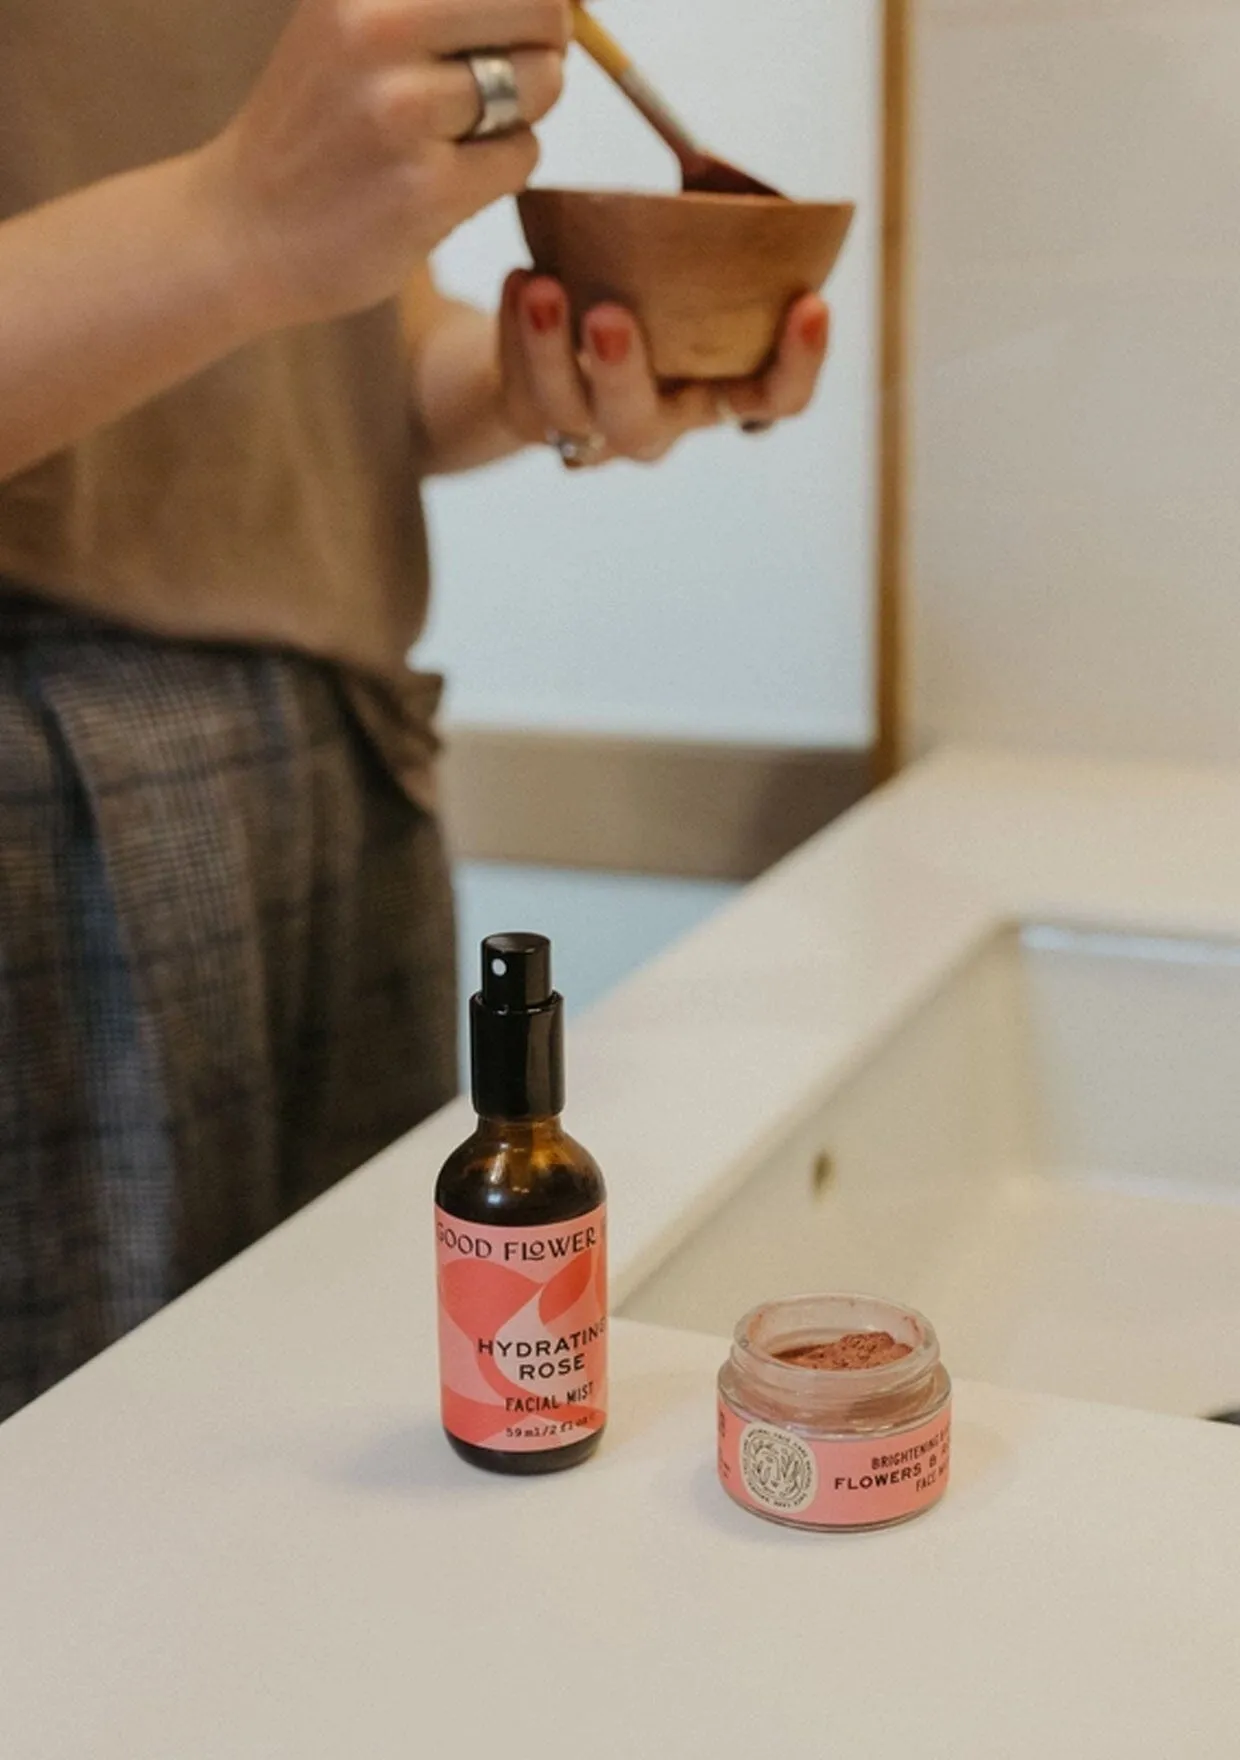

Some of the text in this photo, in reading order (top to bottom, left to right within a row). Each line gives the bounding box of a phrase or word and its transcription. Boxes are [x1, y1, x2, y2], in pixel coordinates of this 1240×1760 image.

[437, 1221, 493, 1259] GOOD
[504, 1226, 597, 1261] FLOWER
[518, 1352, 586, 1381] ROSE
[505, 1381, 594, 1413] FACIAL MIST
[833, 1462, 922, 1491] FLOWERS
